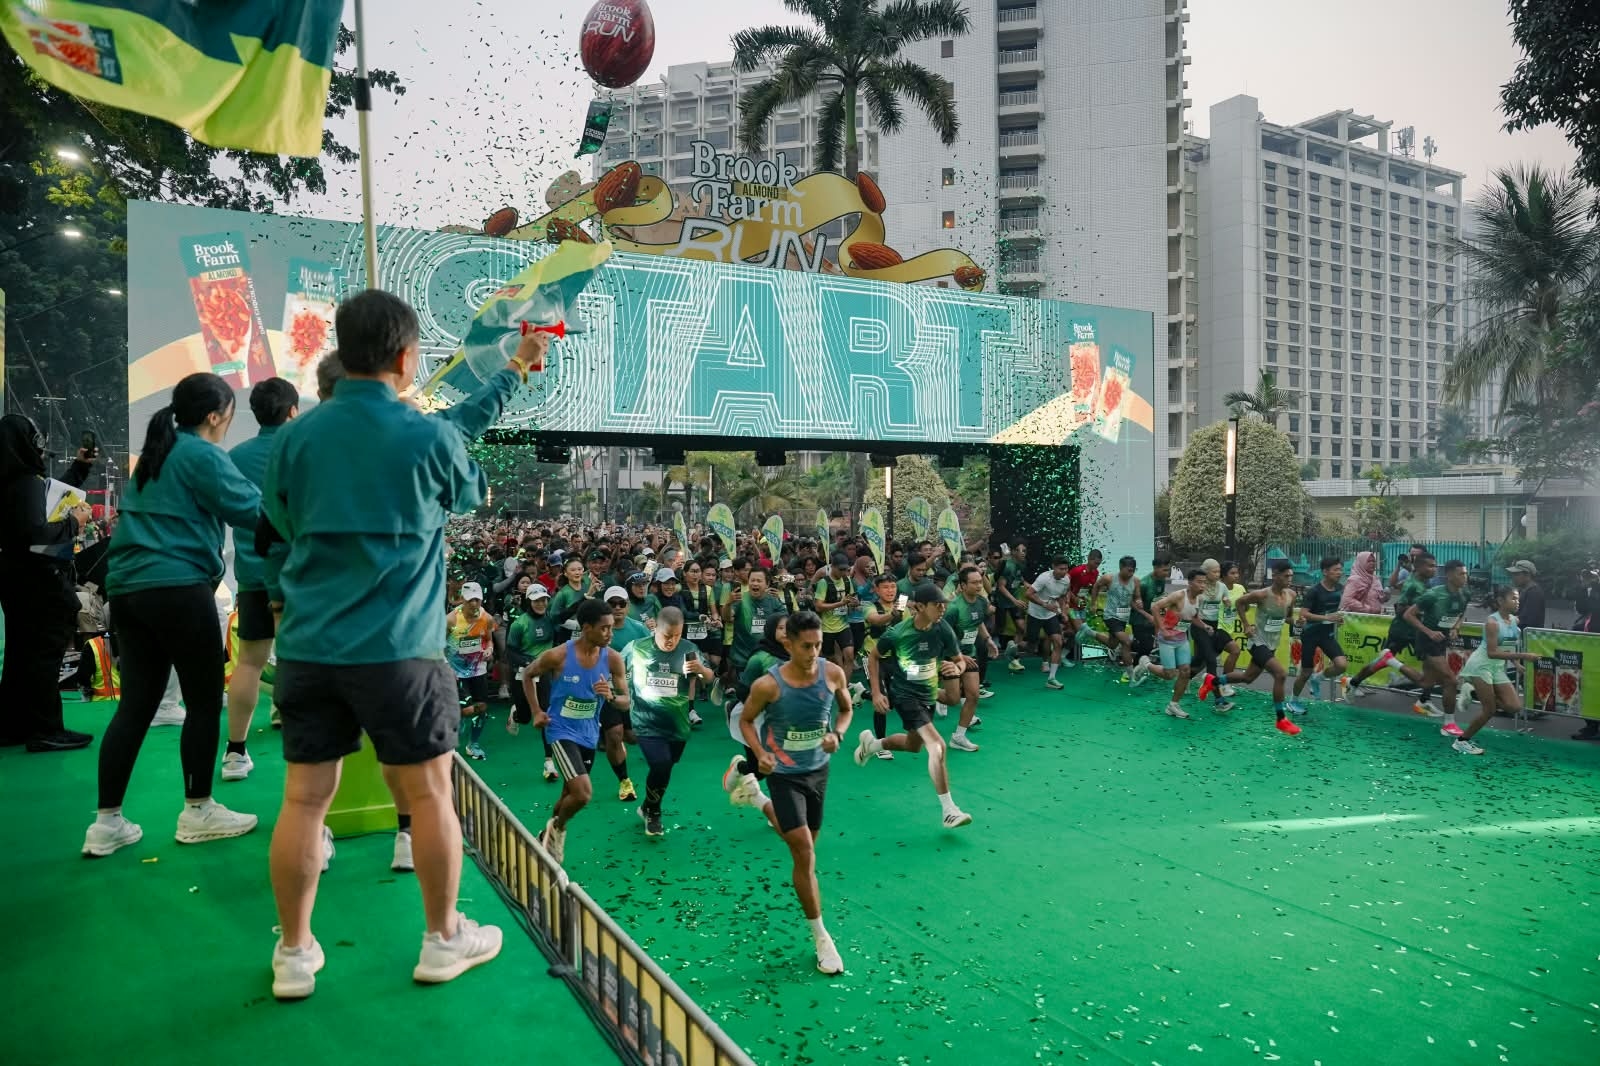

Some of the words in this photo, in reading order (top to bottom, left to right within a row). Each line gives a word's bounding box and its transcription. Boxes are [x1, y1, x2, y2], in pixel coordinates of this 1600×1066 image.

[594, 11, 631, 27] Farm
[598, 3, 632, 20] Brook
[584, 21, 635, 42] RUN
[690, 140, 806, 197] Brook
[742, 184, 779, 199] ALMOND
[691, 180, 804, 228] Farm
[193, 241, 239, 257] Brook
[664, 217, 827, 273] RUN
[196, 254, 240, 267] Farm
[400, 240, 1015, 433] START
[649, 678, 675, 686] 52014
